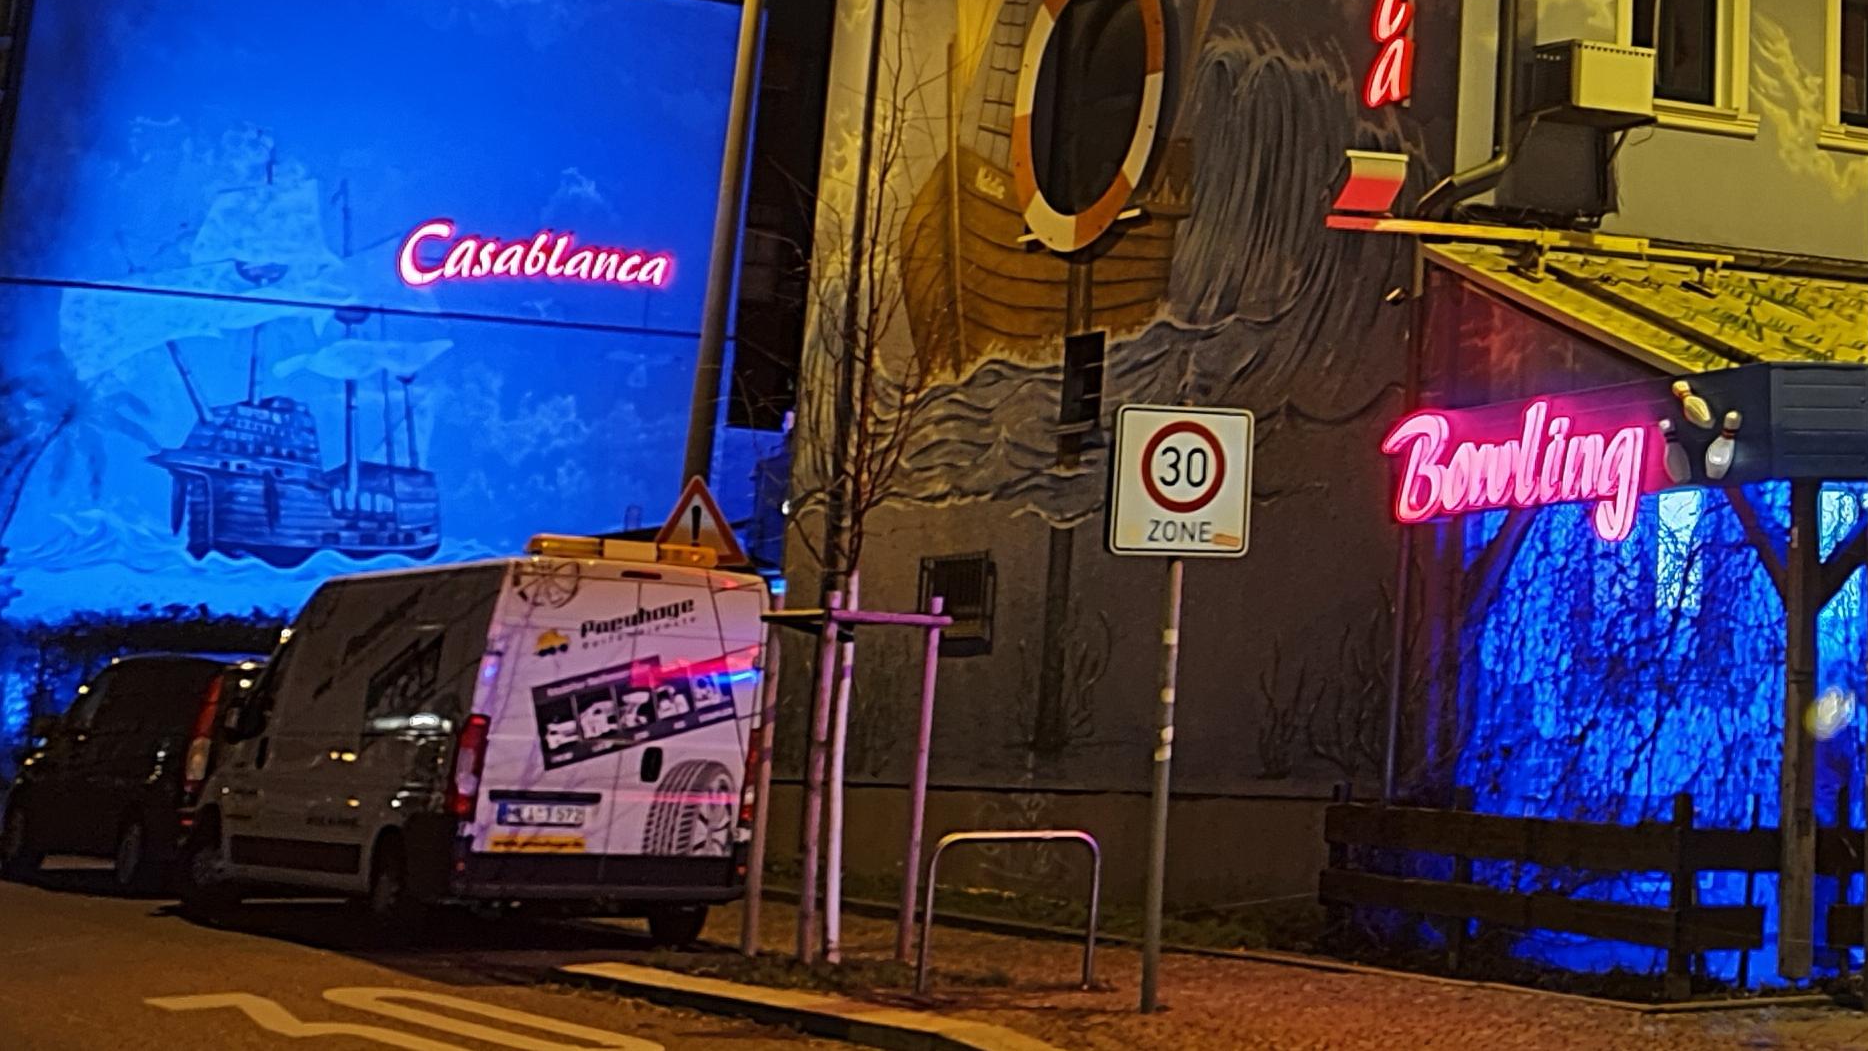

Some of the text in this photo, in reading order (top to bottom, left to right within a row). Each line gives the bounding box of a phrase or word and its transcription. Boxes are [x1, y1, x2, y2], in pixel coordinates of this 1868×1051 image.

[398, 218, 672, 287] Casablanca
[1160, 446, 1208, 488] 30
[1381, 397, 1645, 542] Bowling
[1147, 519, 1213, 543] ZONE
